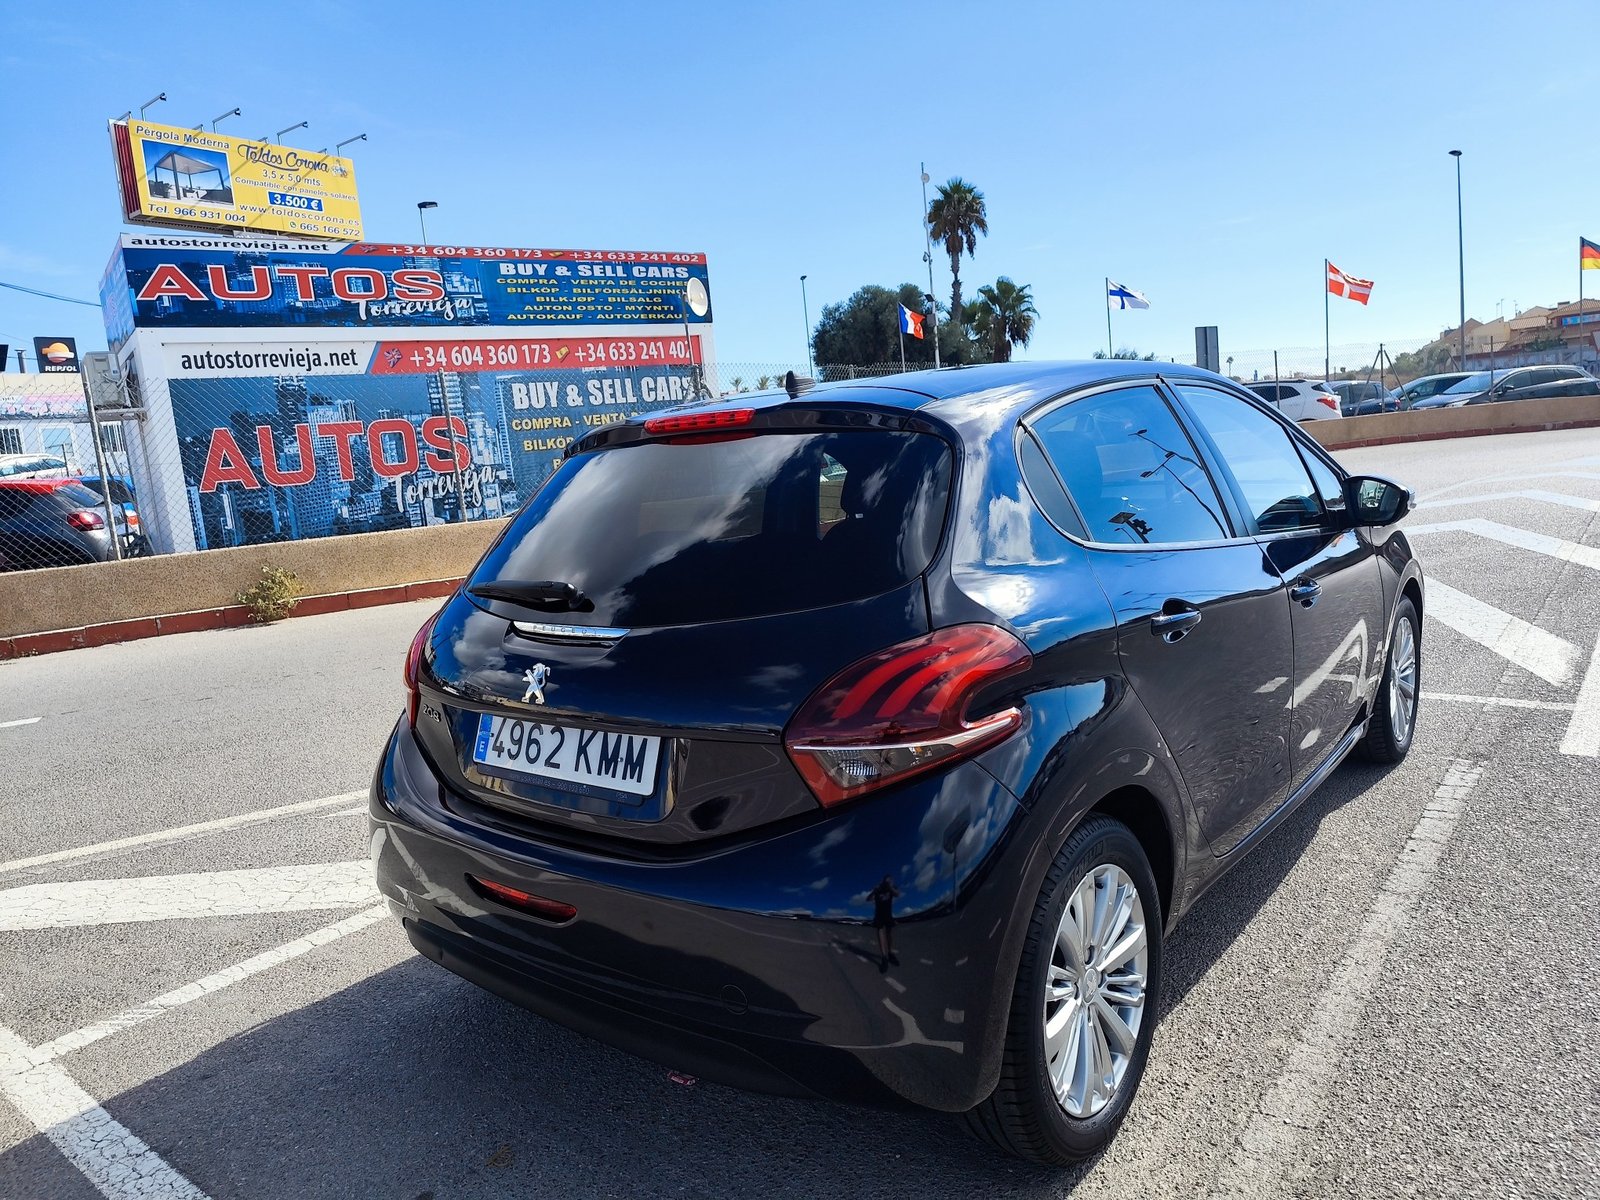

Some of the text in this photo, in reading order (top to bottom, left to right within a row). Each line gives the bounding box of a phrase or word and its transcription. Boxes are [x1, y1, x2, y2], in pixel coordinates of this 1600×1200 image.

[136, 125, 230, 149] Pérgola Moderna
[237, 144, 329, 173] Toldos Corona
[262, 169, 277, 179] 3,5
[287, 173, 302, 183] 5,0
[304, 178, 323, 187] mts.
[235, 176, 281, 189] Compatible
[299, 187, 328, 197] paneles
[330, 192, 357, 201] solares
[273, 194, 320, 210] 3.500 €
[148, 203, 246, 223] Tel. 966 931 004
[300, 223, 360, 237] 665 166 572
[131, 237, 331, 252] autostorrevieja.net
[387, 245, 543, 258] +34 604 360 173
[569, 250, 699, 263] +34 633 241 402
[500, 263, 689, 279] BUY & SELL CARS
[136, 264, 445, 301] AUTOS
[507, 285, 560, 293] BILKÖP
[352, 297, 472, 321] Torrevieja
[624, 304, 675, 312] MYYNTI
[181, 347, 359, 372] autostorrevieja.net
[409, 343, 551, 368] +34 604 360 173
[574, 342, 606, 362] +34
[608, 341, 636, 361] 633
[640, 341, 665, 360] 241
[511, 381, 559, 410] BUY
[565, 384, 584, 408] &
[587, 377, 638, 406] SELL
[511, 416, 572, 431] COMPRA
[200, 415, 471, 493] AUTOS
[388, 465, 497, 513] Torreveja
[479, 740, 486, 752] E
[492, 716, 649, 784] 4962 KMM
